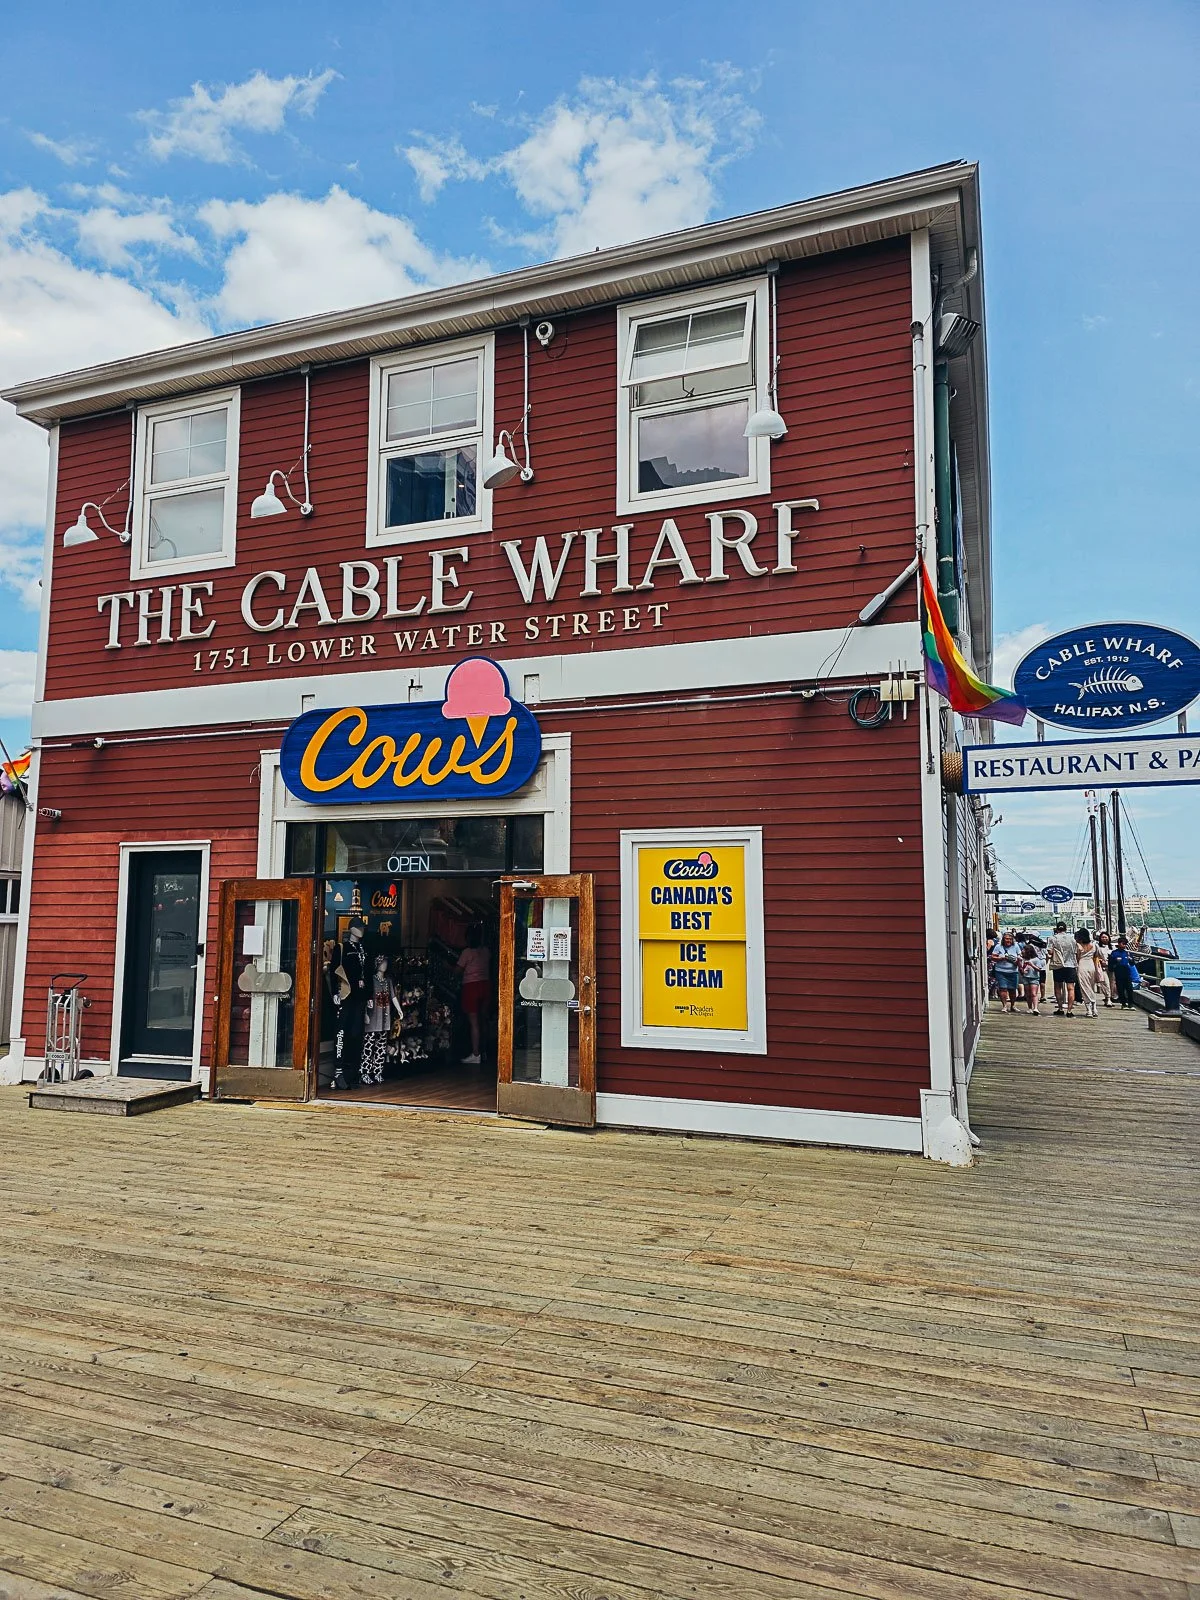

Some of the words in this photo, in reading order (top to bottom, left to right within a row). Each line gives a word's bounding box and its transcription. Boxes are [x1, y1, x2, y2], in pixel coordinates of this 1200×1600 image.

[97, 581, 217, 650] THE
[240, 548, 474, 633] CABLE
[500, 498, 820, 604] WHARF
[193, 646, 250, 672] 1751
[266, 633, 377, 665] LOWER
[393, 621, 508, 652] WATER
[525, 602, 669, 641] STREET
[1035, 639, 1096, 681] CABLE
[1103, 637, 1184, 669] WHARF
[1083, 656, 1104, 667] EST.
[1107, 655, 1130, 663] 1913
[1053, 703, 1124, 718] HALIFAX
[1129, 698, 1166, 714] N.S.
[974, 752, 1139, 778] RESTAURANT
[1148, 750, 1169, 769] &
[387, 855, 430, 873] OPEN
[650, 886, 733, 905] CANADA'S
[670, 911, 712, 930] BEST
[679, 943, 707, 963] ICE
[665, 968, 723, 989] CREAM
[336, 1029, 344, 1059] Halifax
